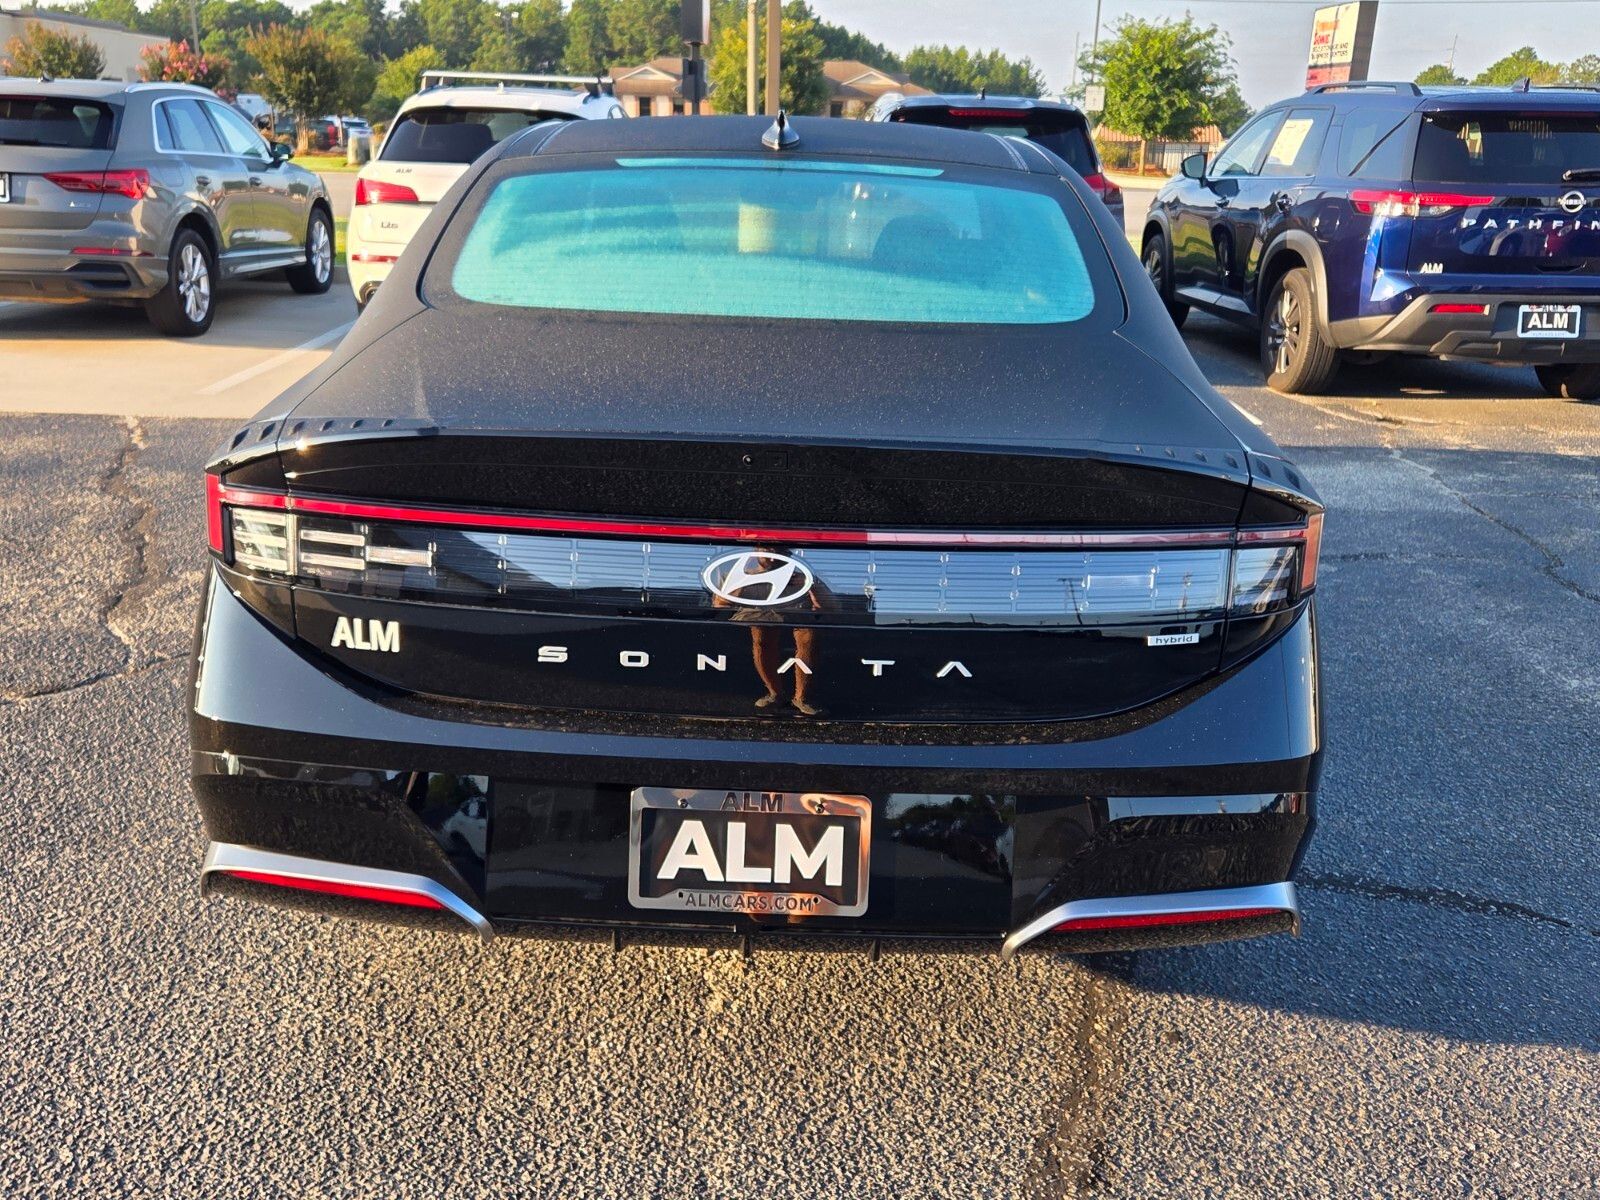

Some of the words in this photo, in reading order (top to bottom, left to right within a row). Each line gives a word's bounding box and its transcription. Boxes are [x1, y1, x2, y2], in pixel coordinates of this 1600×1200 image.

[1420, 263, 1443, 274] ALM
[1527, 313, 1569, 328] ALM
[330, 615, 401, 653] ALM
[1155, 635, 1193, 646] hybrid
[537, 645, 973, 679] SONATA
[720, 791, 784, 813] ALM
[656, 819, 845, 887] ALM
[685, 892, 813, 912] ALMCARS.COM
